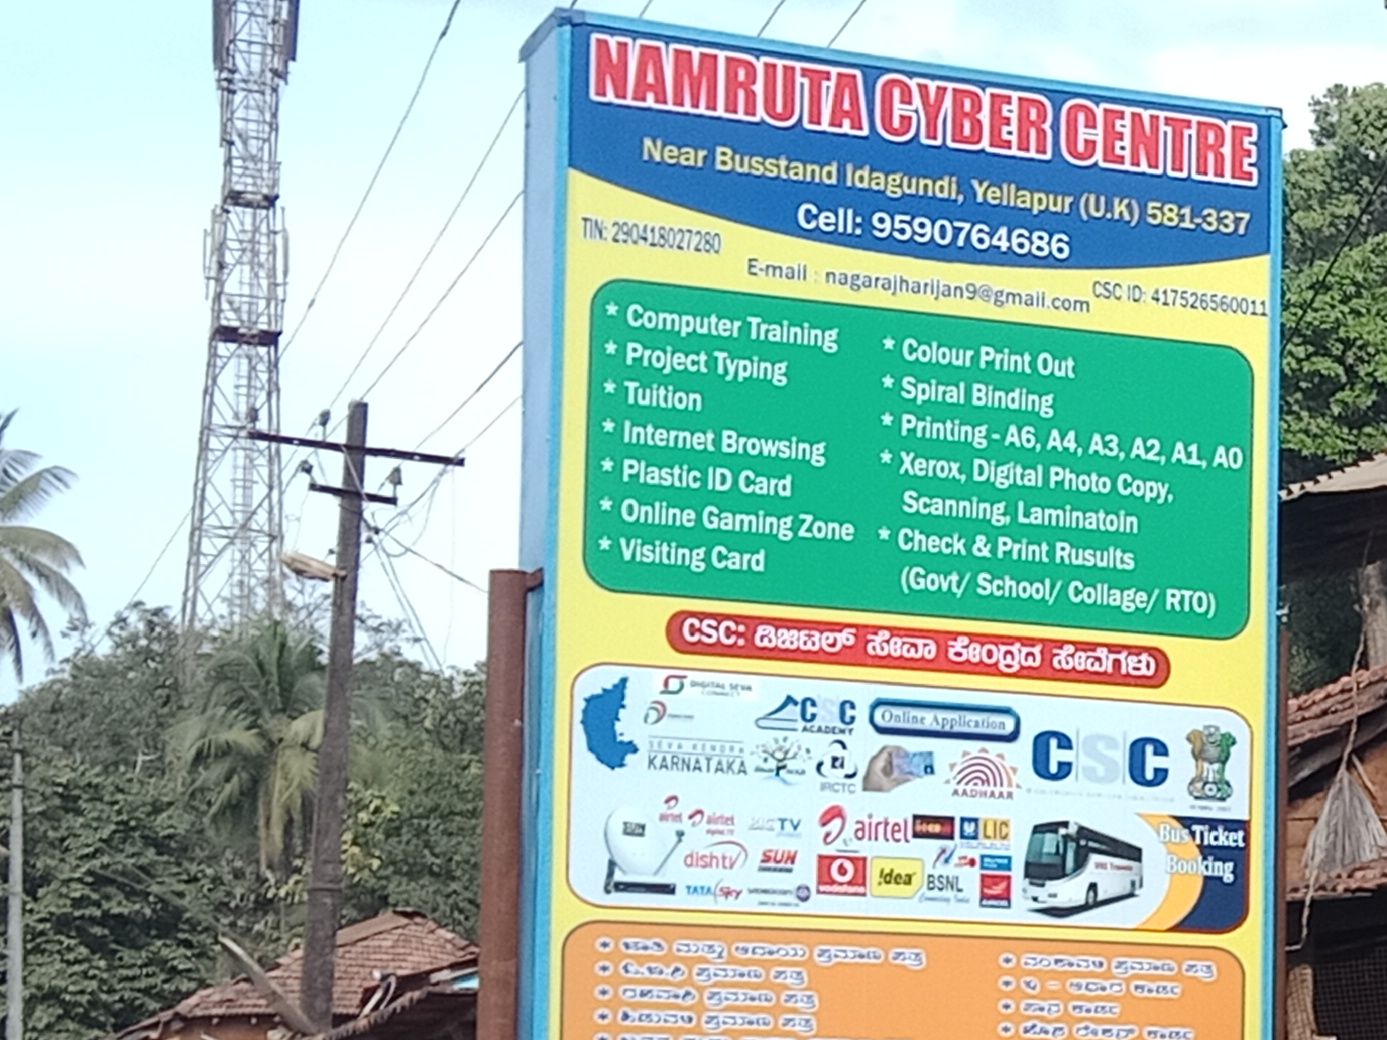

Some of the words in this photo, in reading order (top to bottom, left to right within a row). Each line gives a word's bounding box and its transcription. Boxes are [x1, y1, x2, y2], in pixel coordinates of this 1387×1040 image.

[590, 33, 868, 136] NAMRUTA
[875, 73, 1052, 161] CYBER
[1062, 99, 1259, 187] CENTRE
[642, 137, 708, 169] Near
[715, 145, 838, 185] Busstand
[845, 162, 964, 206] Idagundi,
[972, 178, 1073, 216] Yellapur
[1079, 193, 1140, 227] (U.K)
[1147, 202, 1250, 236] 581-337
[582, 217, 608, 241] TIN:
[611, 221, 721, 254] 290418027280
[797, 203, 862, 236] Cell:
[871, 211, 1071, 260] 9590764686
[747, 258, 807, 281] E-mail
[825, 269, 1089, 313] nagarajharijan9@gmail.com
[1092, 280, 1123, 300] CSC
[1151, 287, 1268, 317] 417526560011
[626, 304, 741, 338] Computer
[747, 316, 839, 354] Training
[625, 342, 707, 374] Project
[714, 352, 788, 387] Typing
[902, 337, 974, 368] Colour
[979, 345, 1031, 374] Print
[1037, 352, 1075, 379] Out
[624, 381, 702, 411] Tuition
[901, 376, 965, 405] Spiral
[972, 382, 1055, 418] Binding
[624, 420, 715, 451] Internet
[721, 430, 826, 467] Browsing
[901, 413, 988, 449] Printing
[1004, 425, 1041, 452] A6,
[1046, 428, 1083, 457] A4,
[1088, 432, 1125, 461] A3,
[1130, 437, 1166, 466] A2,
[1171, 442, 1207, 470] A1,
[623, 459, 701, 489] Plastic
[707, 466, 732, 491] ID
[738, 470, 792, 497] Card
[899, 452, 966, 485] Xerox,
[972, 458, 1043, 489] Digital
[1049, 466, 1111, 495] Photo
[1117, 473, 1173, 505] Copy,
[621, 498, 696, 527] Online
[703, 505, 793, 541] Gaming
[798, 514, 855, 541] Zone
[902, 490, 1011, 526] Scanning,
[1017, 501, 1139, 534] Laminatoin
[619, 537, 706, 572] Visiting
[711, 545, 766, 572] Card
[898, 527, 966, 557] Check
[972, 535, 991, 558] &
[997, 538, 1049, 563] Print
[1055, 542, 1135, 570] Rusults
[901, 565, 972, 598] (Govt/
[976, 571, 1063, 605] School/
[1067, 580, 1160, 614] Collage/
[1165, 588, 1217, 618] RTO)
[682, 616, 746, 647] CSC:
[866, 629, 937, 661] ಸೇವಾ
[947, 635, 1043, 673] ಕೇಂದ್ರದ
[1051, 643, 1157, 677] ಸೇವೆಗಳು
[881, 709, 926, 725] Online
[930, 714, 1007, 731] Application
[647, 754, 748, 776] KARNATAKA
[1032, 730, 1169, 788] CSC
[951, 788, 1014, 801] AADHAAR
[854, 813, 910, 843] airtel
[983, 821, 1009, 840] LIC
[1159, 823, 1190, 845] Bus
[1191, 824, 1246, 848] Ticket
[685, 885, 712, 896] TATA
[927, 874, 963, 892] BSNL
[1166, 854, 1235, 885] Booking
